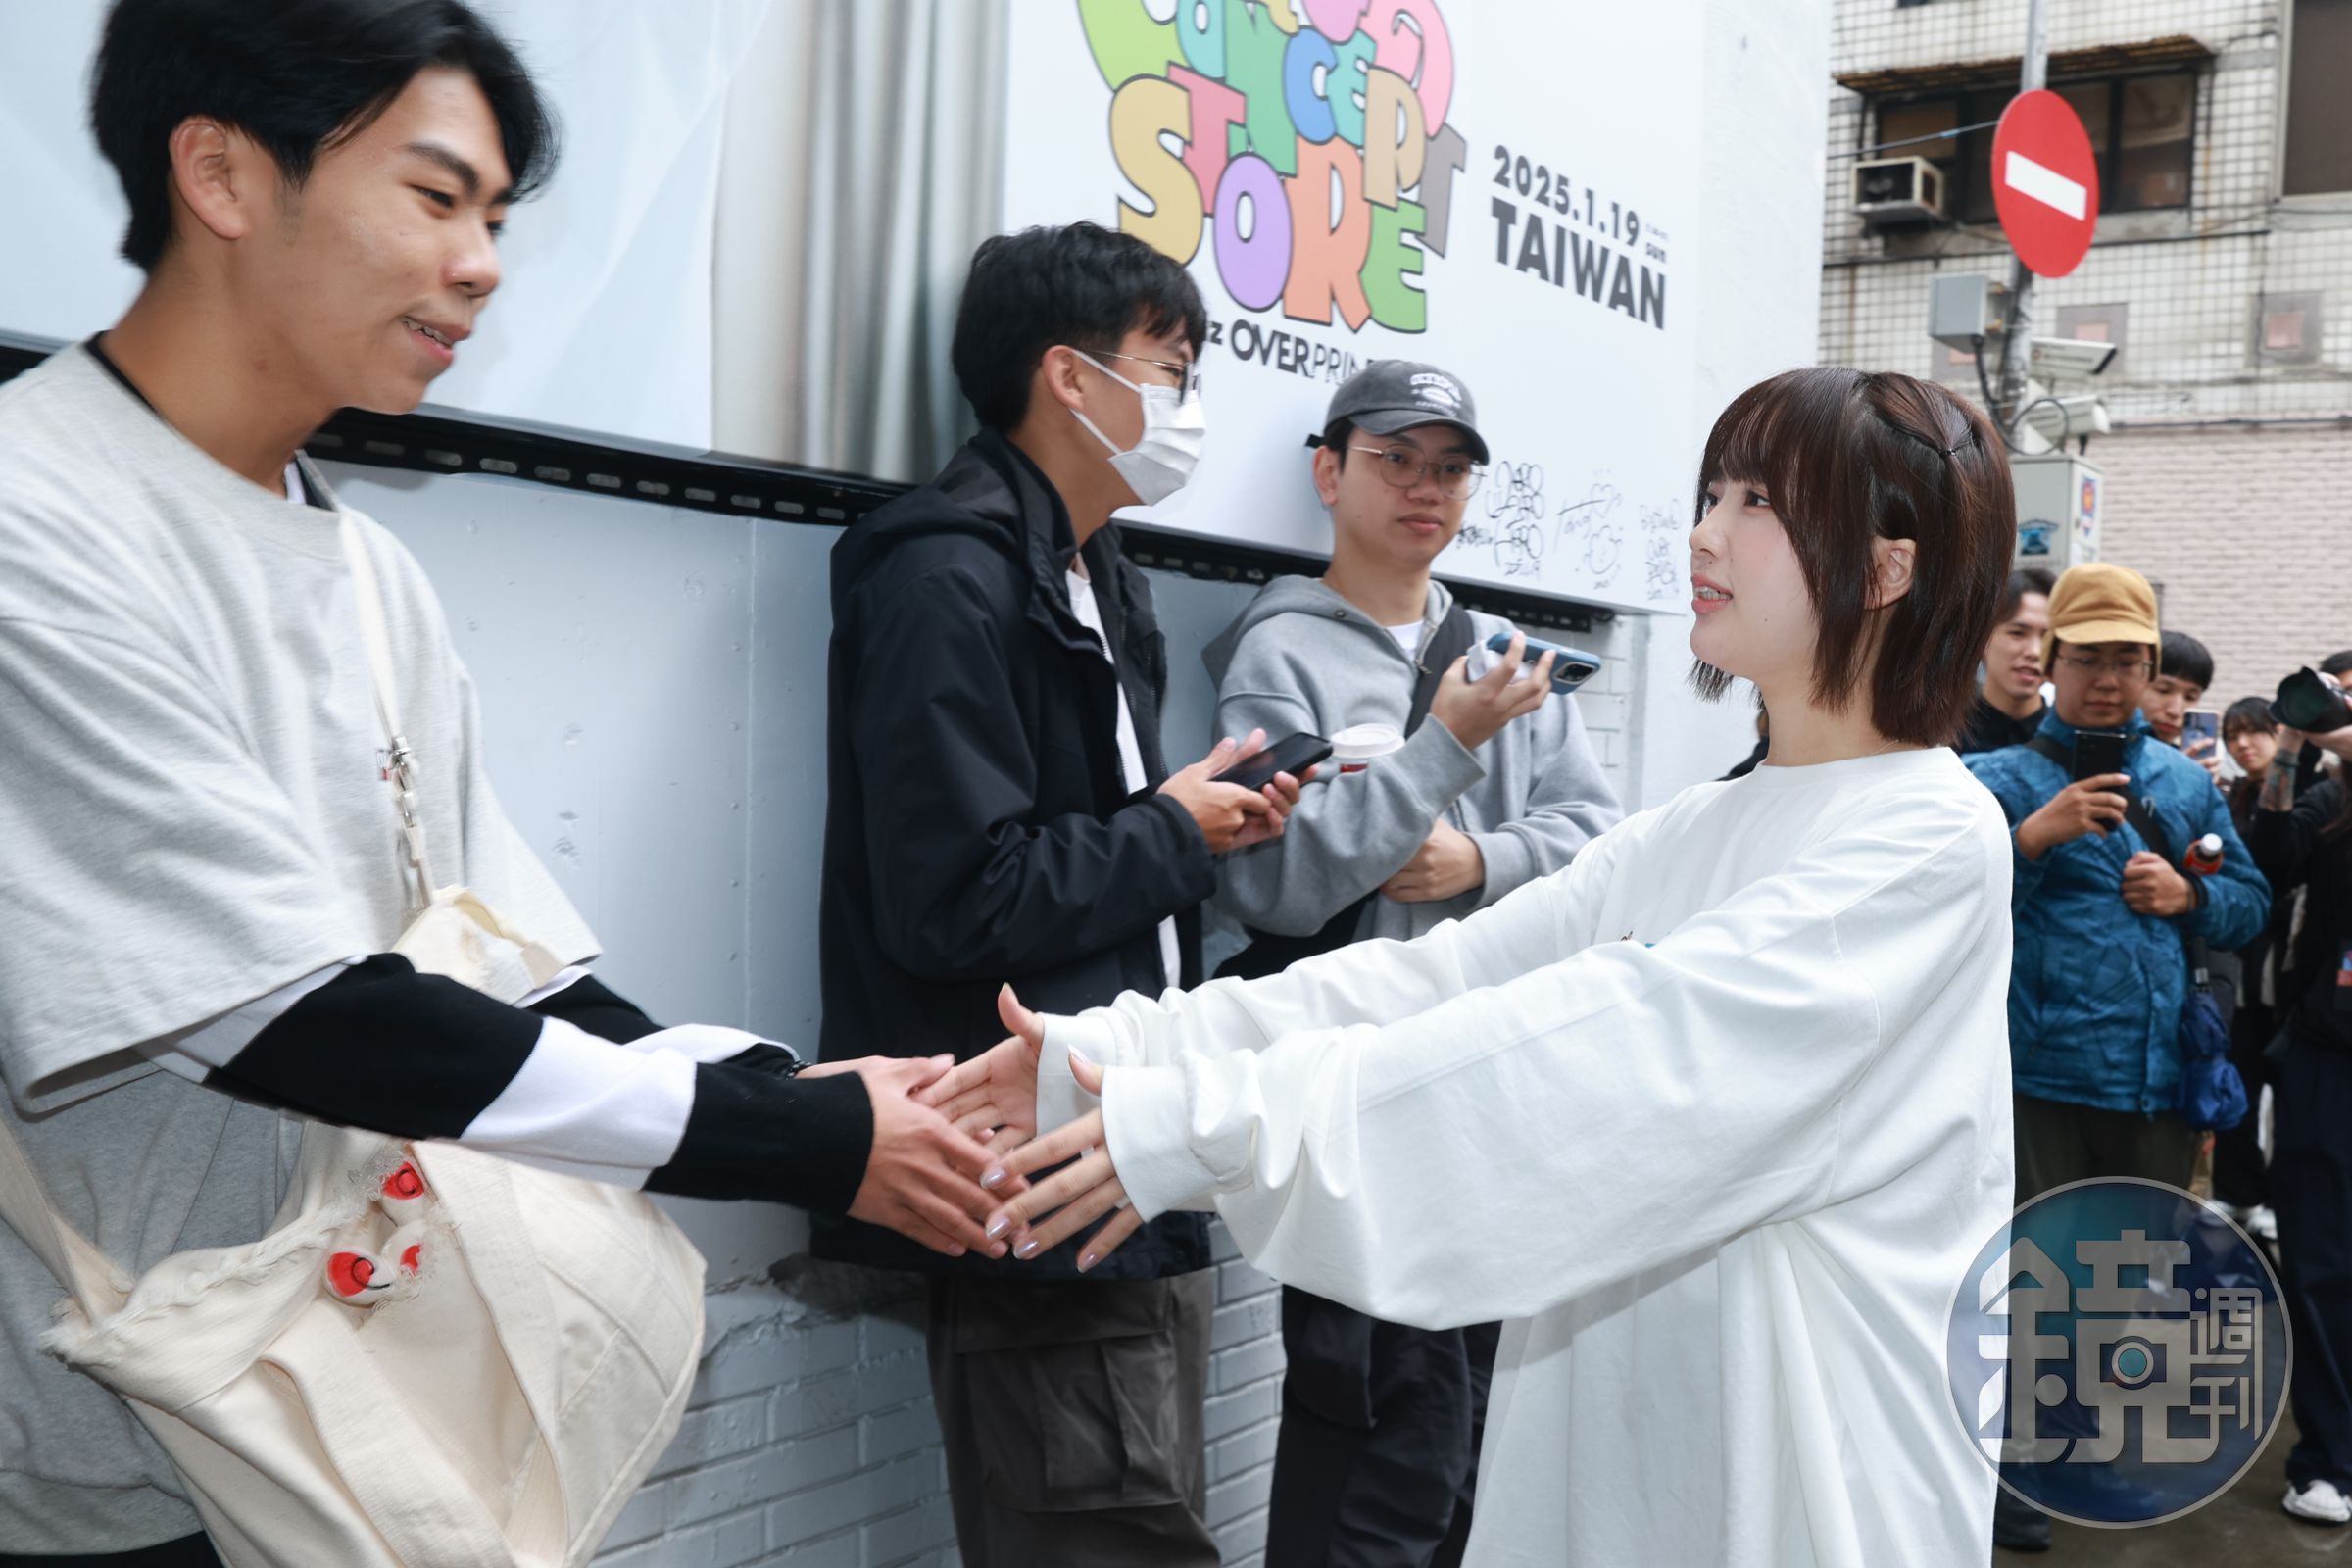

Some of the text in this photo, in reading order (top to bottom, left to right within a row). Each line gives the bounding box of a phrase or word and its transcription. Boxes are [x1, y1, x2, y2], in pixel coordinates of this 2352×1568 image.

[1109, 61, 1426, 334] STORE
[1493, 144, 1640, 247] 2025.1.19
[1491, 196, 1665, 331] TAIWAN
